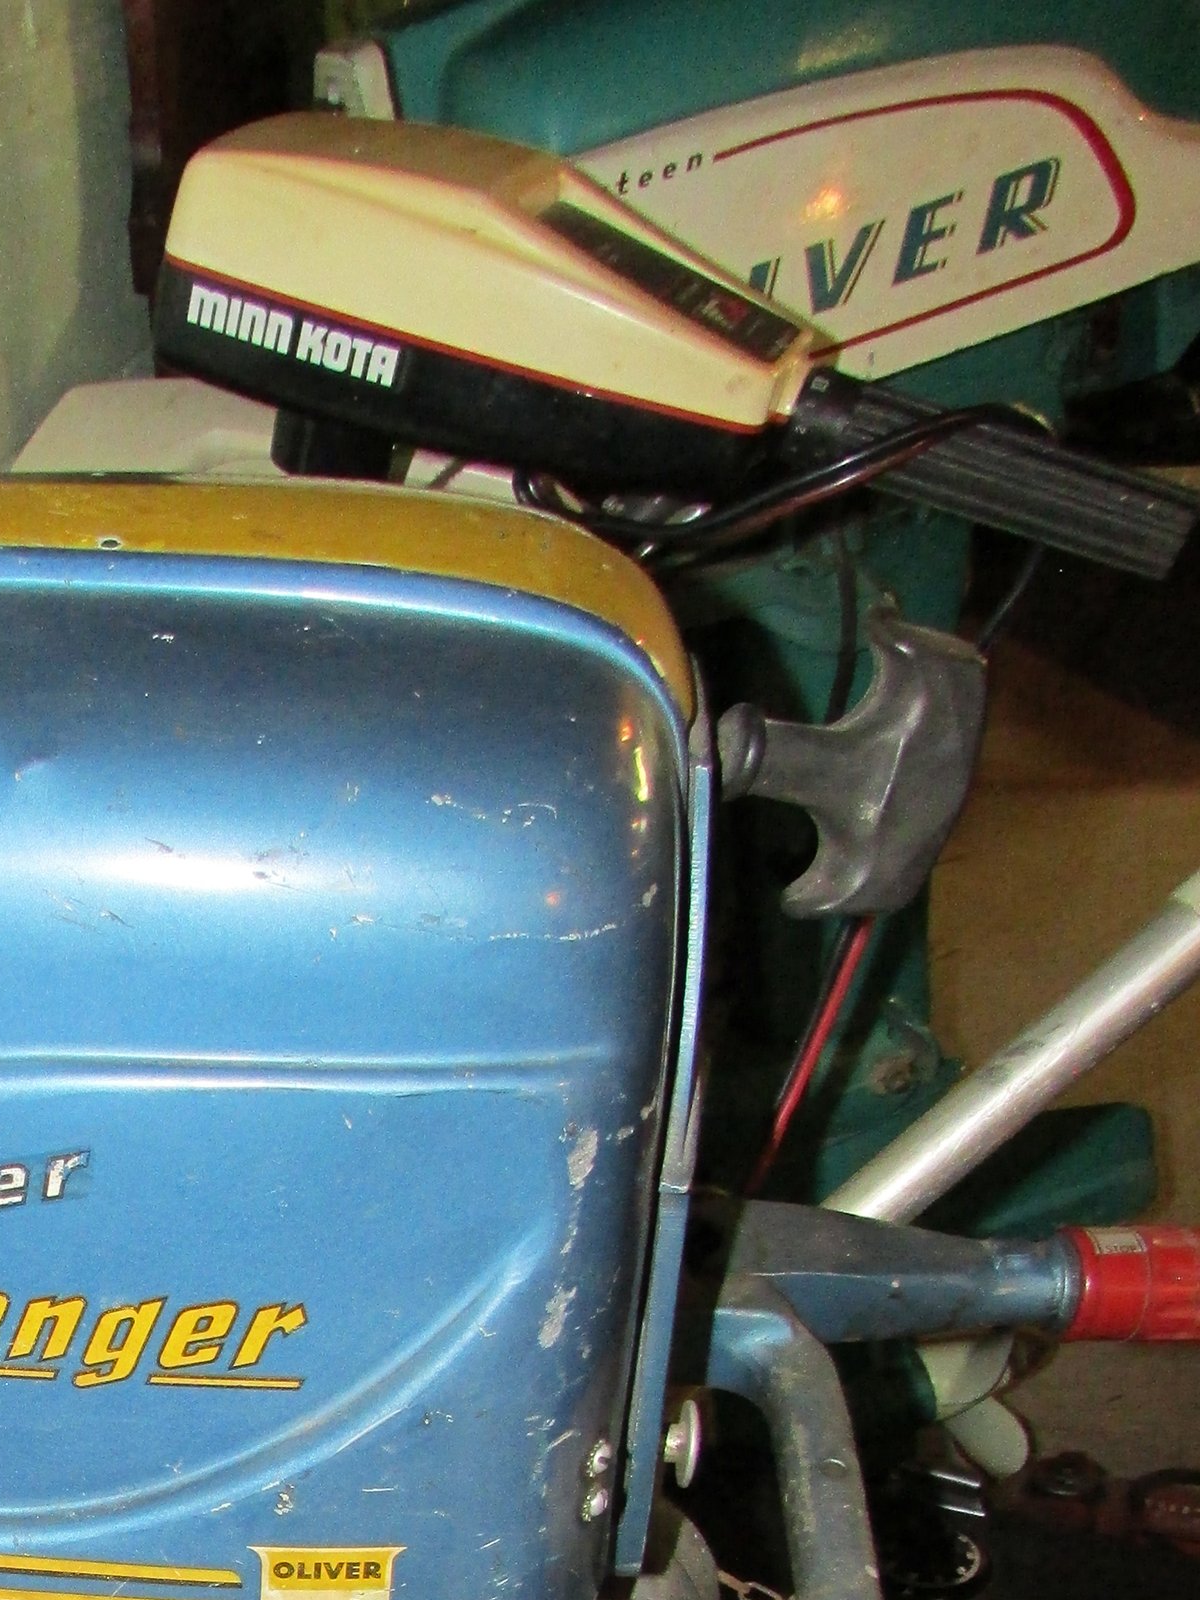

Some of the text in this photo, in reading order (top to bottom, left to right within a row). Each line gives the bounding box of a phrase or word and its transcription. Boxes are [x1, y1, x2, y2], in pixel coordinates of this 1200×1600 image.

[600, 152, 703, 196] teen
[187, 283, 400, 388] MINN KOTA
[273, 1561, 382, 1580] OLIVER
